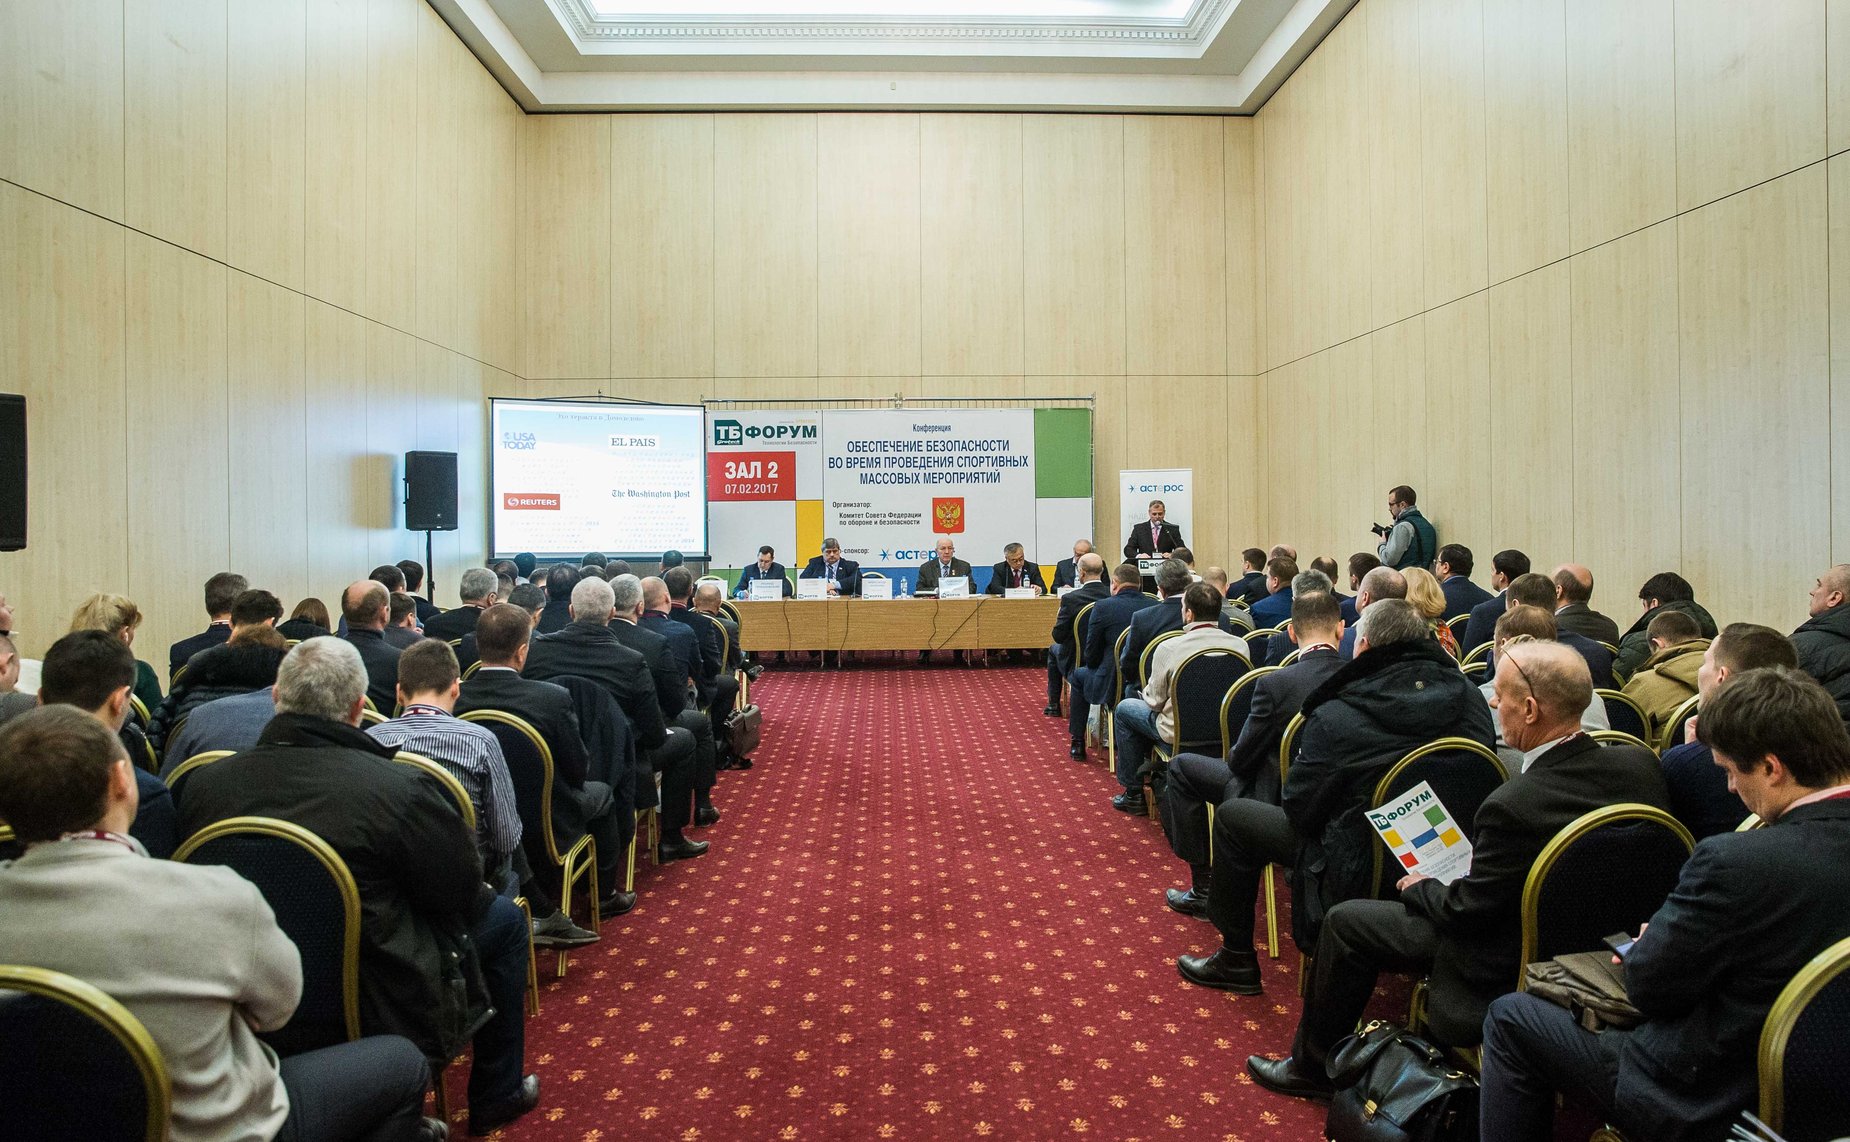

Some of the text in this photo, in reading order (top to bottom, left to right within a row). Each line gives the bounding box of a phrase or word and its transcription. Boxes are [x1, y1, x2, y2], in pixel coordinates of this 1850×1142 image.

[716, 425, 817, 439] ТБ ФОРУМ
[913, 424, 951, 433] Конференция
[513, 432, 536, 441] USA
[503, 441, 536, 450] TODAY
[611, 437, 627, 447] EL
[847, 440, 1010, 453] ОБЕСПЕЧЕНИЕ БЕЗОПАСНОСТИ
[828, 455, 1029, 470] ВО ВРЕМЯ ПРОВЕДЕНИЯ СПОРТИВНЫХ
[724, 461, 779, 479] ЗАЛ 2
[859, 469, 1001, 485] МАССОВЫХ МЕРОПРИЯТИЙ
[611, 488, 691, 499] The Washington Post
[724, 484, 779, 494] 07.02.2017
[832, 501, 872, 509] Организатор:
[895, 550, 937, 560] астер
[1387, 790, 1432, 821] ФОРУМ
